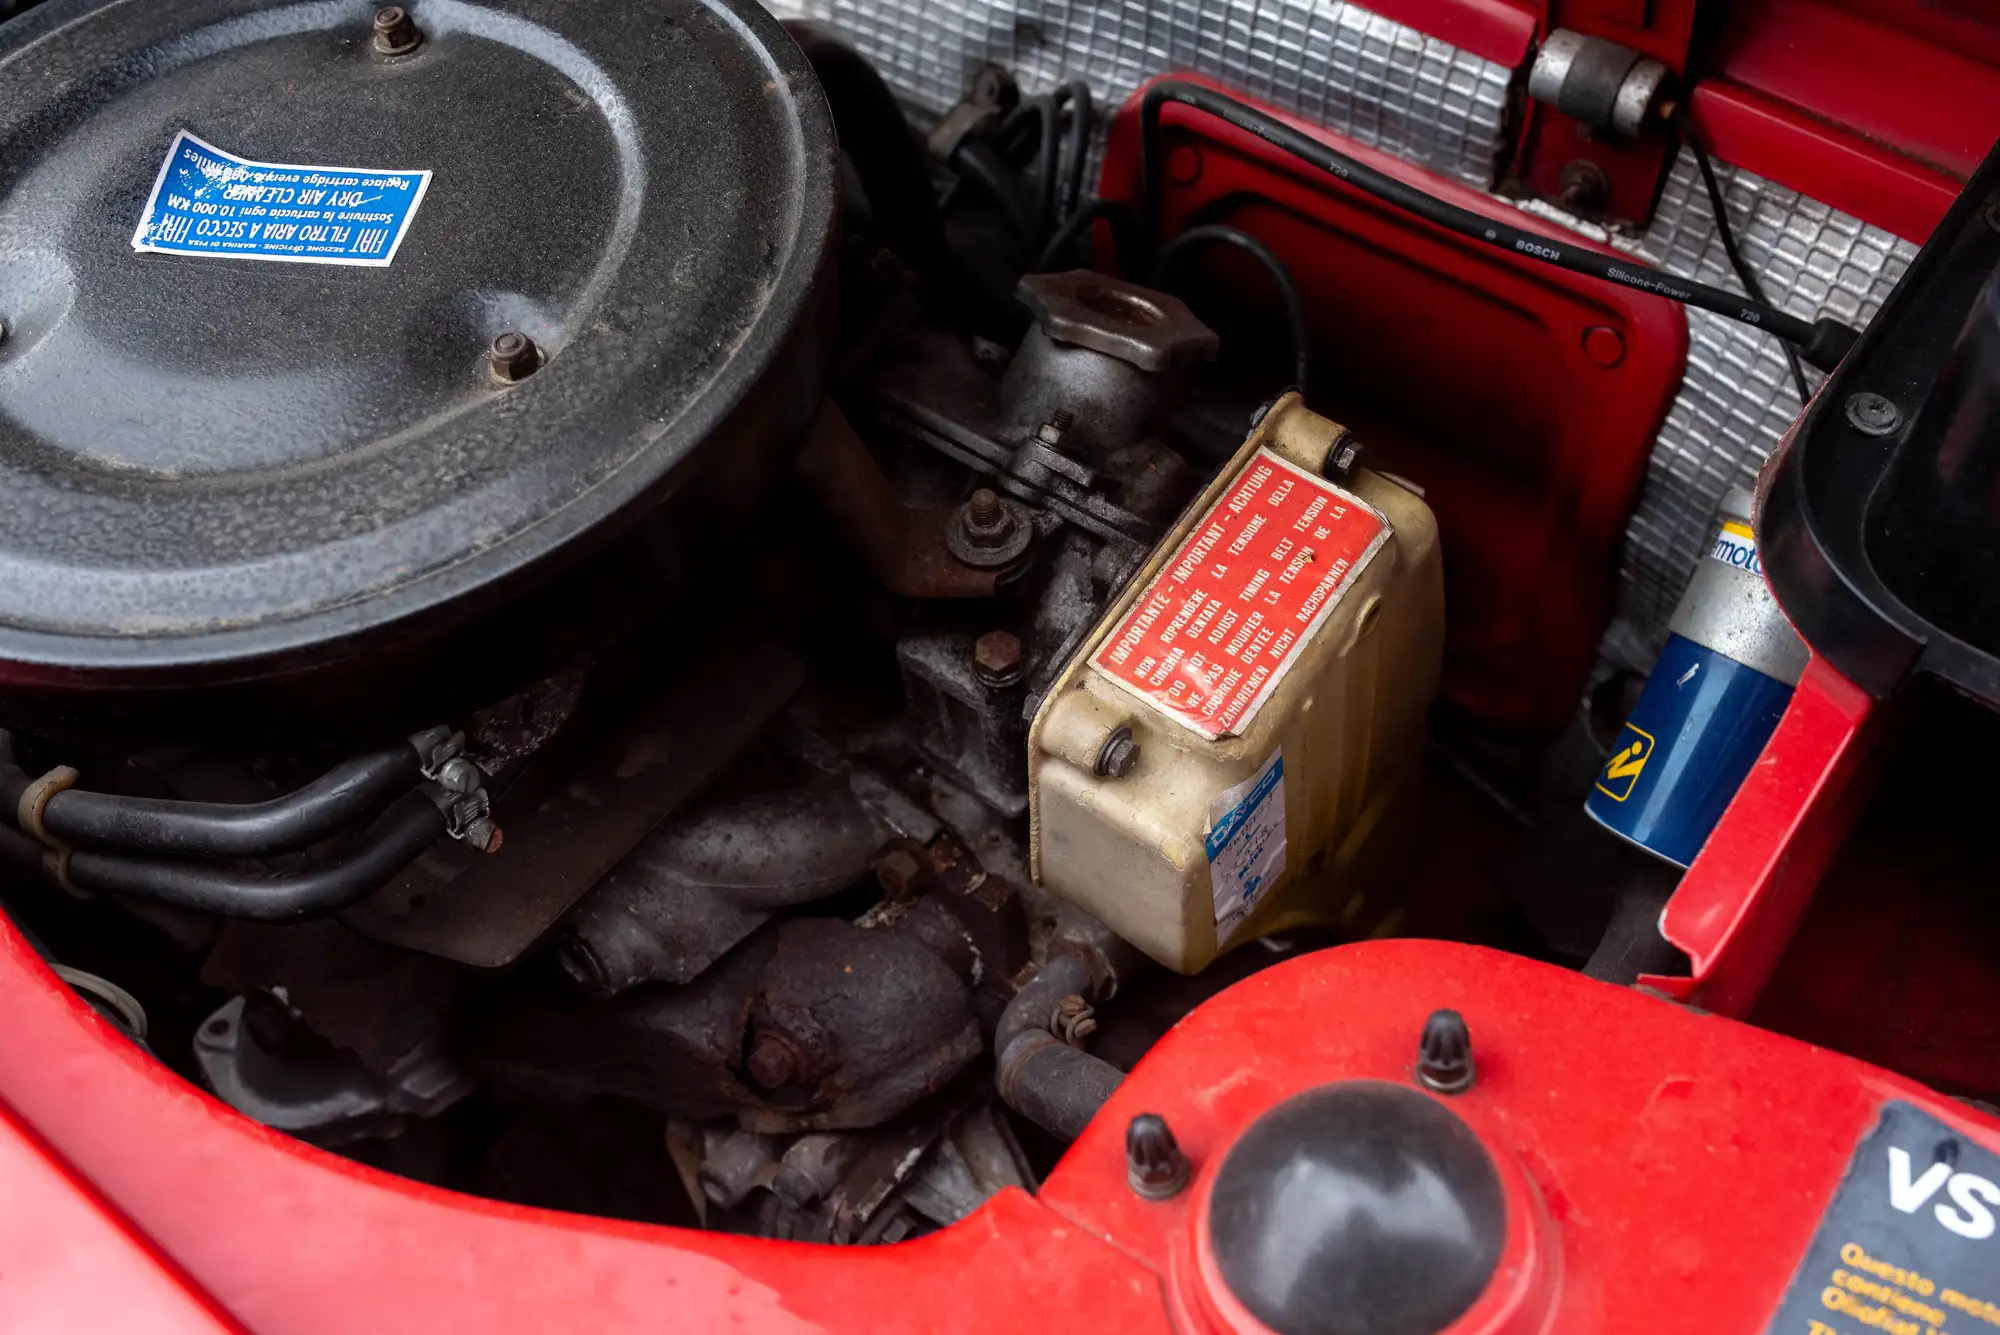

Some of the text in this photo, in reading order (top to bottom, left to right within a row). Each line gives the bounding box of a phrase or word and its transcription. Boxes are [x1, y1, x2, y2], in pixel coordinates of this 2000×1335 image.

[167, 193, 393, 224] Sostituire la cartuccia ogni 10.000 KM
[223, 183, 363, 208] DRY AIR CLEANER
[303, 174, 359, 188] cartridge
[362, 178, 410, 191] Replace
[152, 213, 193, 243] FIAT
[196, 219, 351, 243] FILTRO ARIA A SECCO
[263, 243, 304, 253] OFFICINE
[306, 245, 344, 253] SEZIONE
[348, 229, 388, 253] FIAT
[1516, 240, 1761, 323] BOSCH Silicone-Power 720
[1110, 593, 1170, 665] IMPORTANTE
[1172, 522, 1225, 584] IMPORTANT
[1231, 466, 1272, 515] ACHTUNG
[1135, 478, 1295, 679] NON RIPRENDERE LA TENSIONE DELLA
[1169, 680, 1186, 697] DO
[1207, 609, 1239, 645] ADJUST
[1239, 568, 1270, 602] TIMING
[1271, 538, 1294, 562] BELT
[1294, 495, 1329, 534] TENSION
[1187, 505, 1346, 707] NE PAS MODIFIER LA TENSION DE LA
[1150, 599, 1223, 687] CINGHIA DENTATA
[1219, 665, 1270, 727] ZAHNRIEMEN
[1269, 628, 1296, 659] NICHT
[1296, 558, 1349, 623] NACHSPANNEN
[1201, 627, 1275, 717] COURROIE DENTEE
[1888, 1146, 2000, 1239] VS
